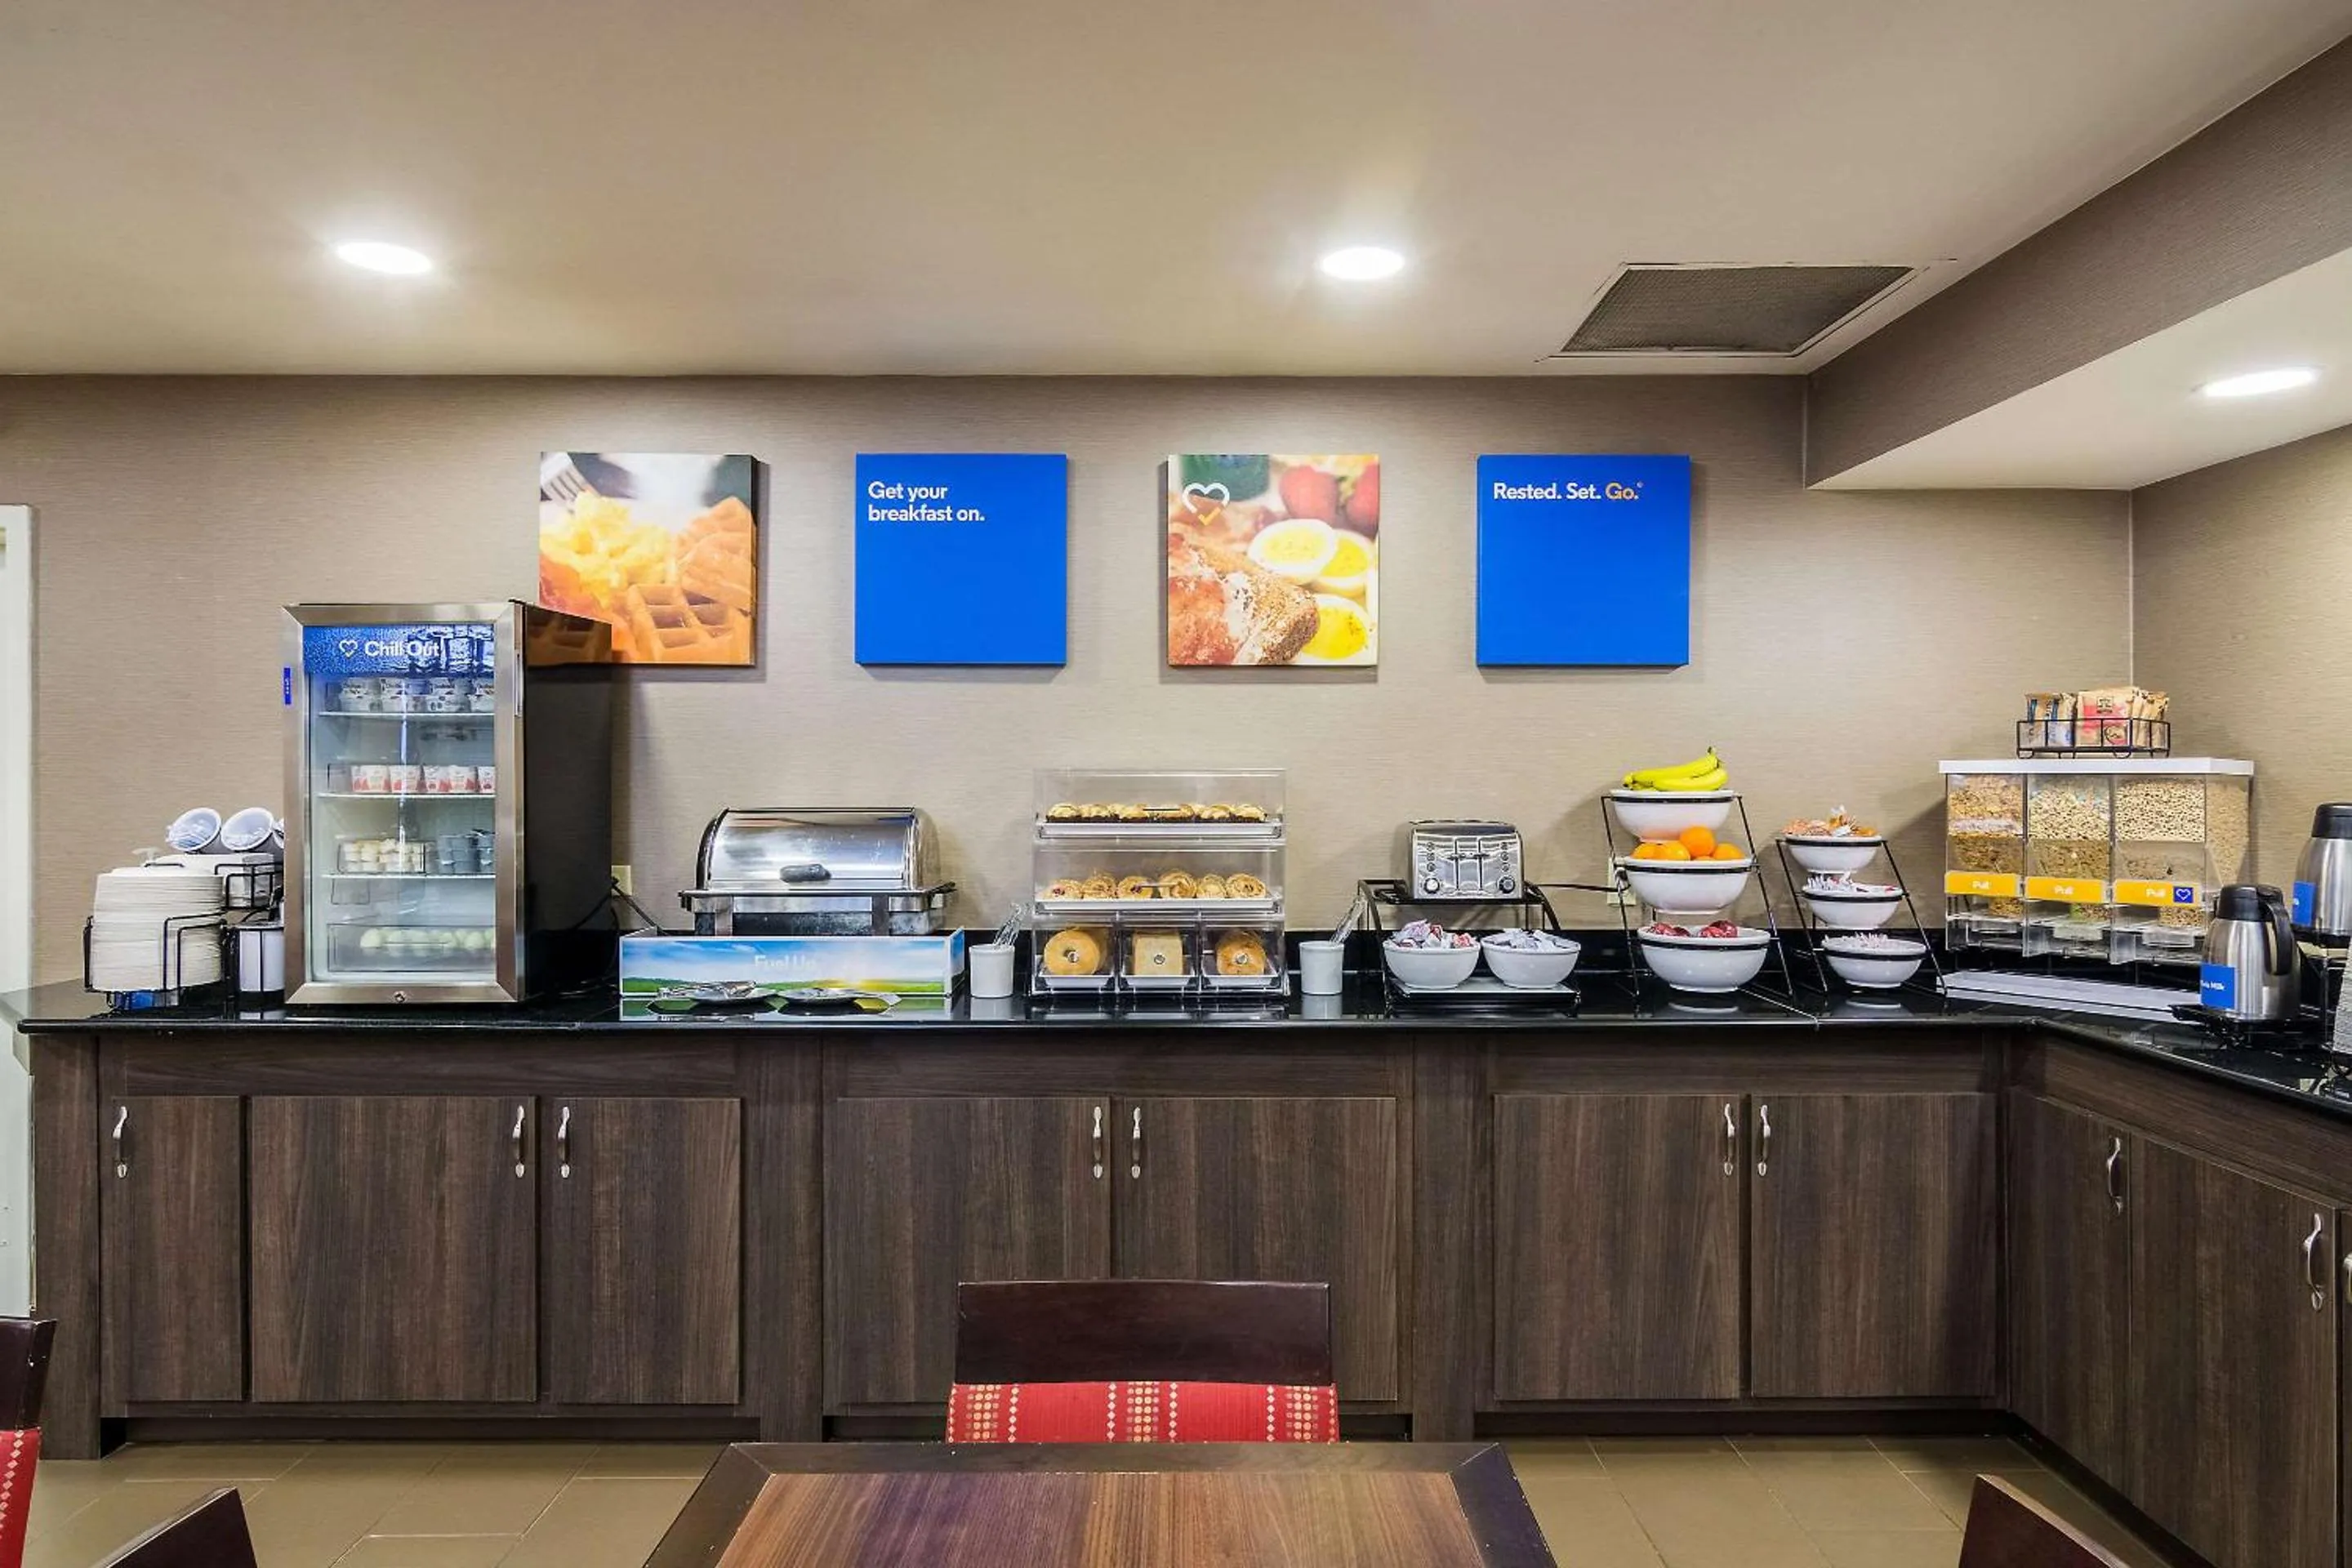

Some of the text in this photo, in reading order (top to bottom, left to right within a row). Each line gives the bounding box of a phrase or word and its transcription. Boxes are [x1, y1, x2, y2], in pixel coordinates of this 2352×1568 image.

[868, 481, 948, 502] Get your
[1494, 482, 1561, 500] Rested.
[1566, 482, 1601, 500] Set.
[868, 504, 986, 522] breakfast on.
[364, 640, 440, 657] Chill Out
[755, 955, 789, 970] Fuel
